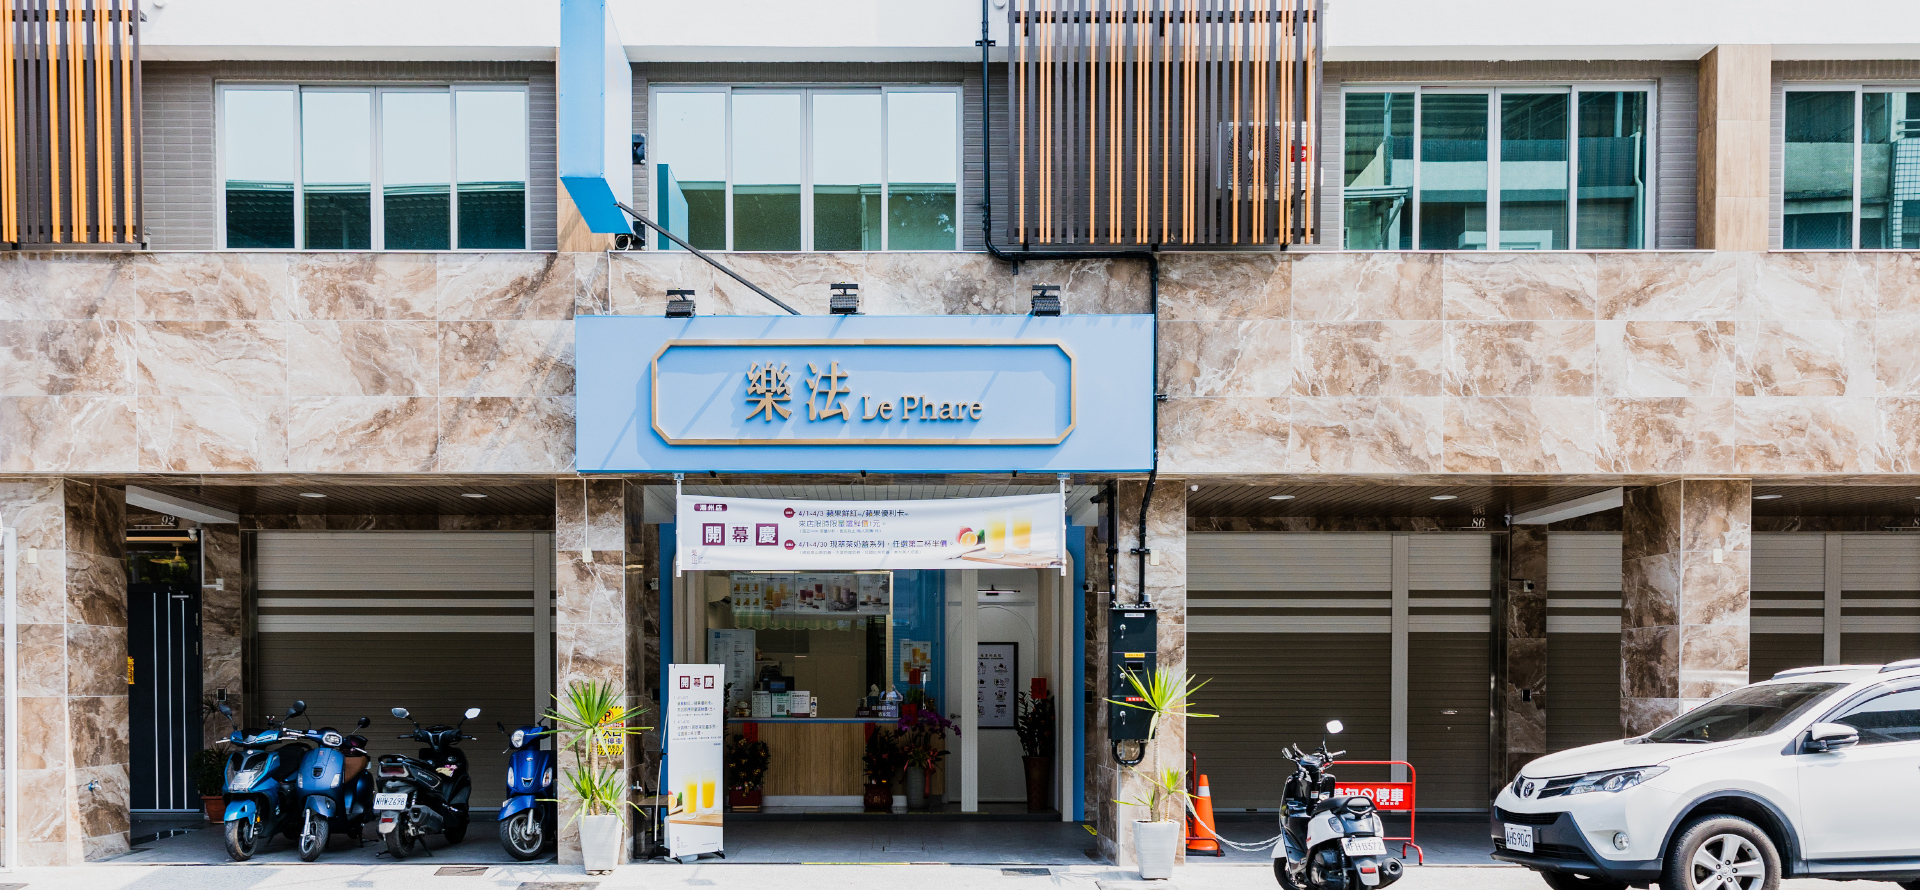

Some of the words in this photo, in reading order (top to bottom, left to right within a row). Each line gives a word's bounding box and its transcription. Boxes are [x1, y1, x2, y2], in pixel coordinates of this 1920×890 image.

[746, 360, 850, 422] 樂法
[862, 395, 893, 420] Le
[902, 394, 983, 420] Phare
[161, 515, 176, 526] 92
[1471, 517, 1486, 528] 86
[704, 524, 778, 545] 開幕慶
[1376, 787, 1404, 803] 停車
